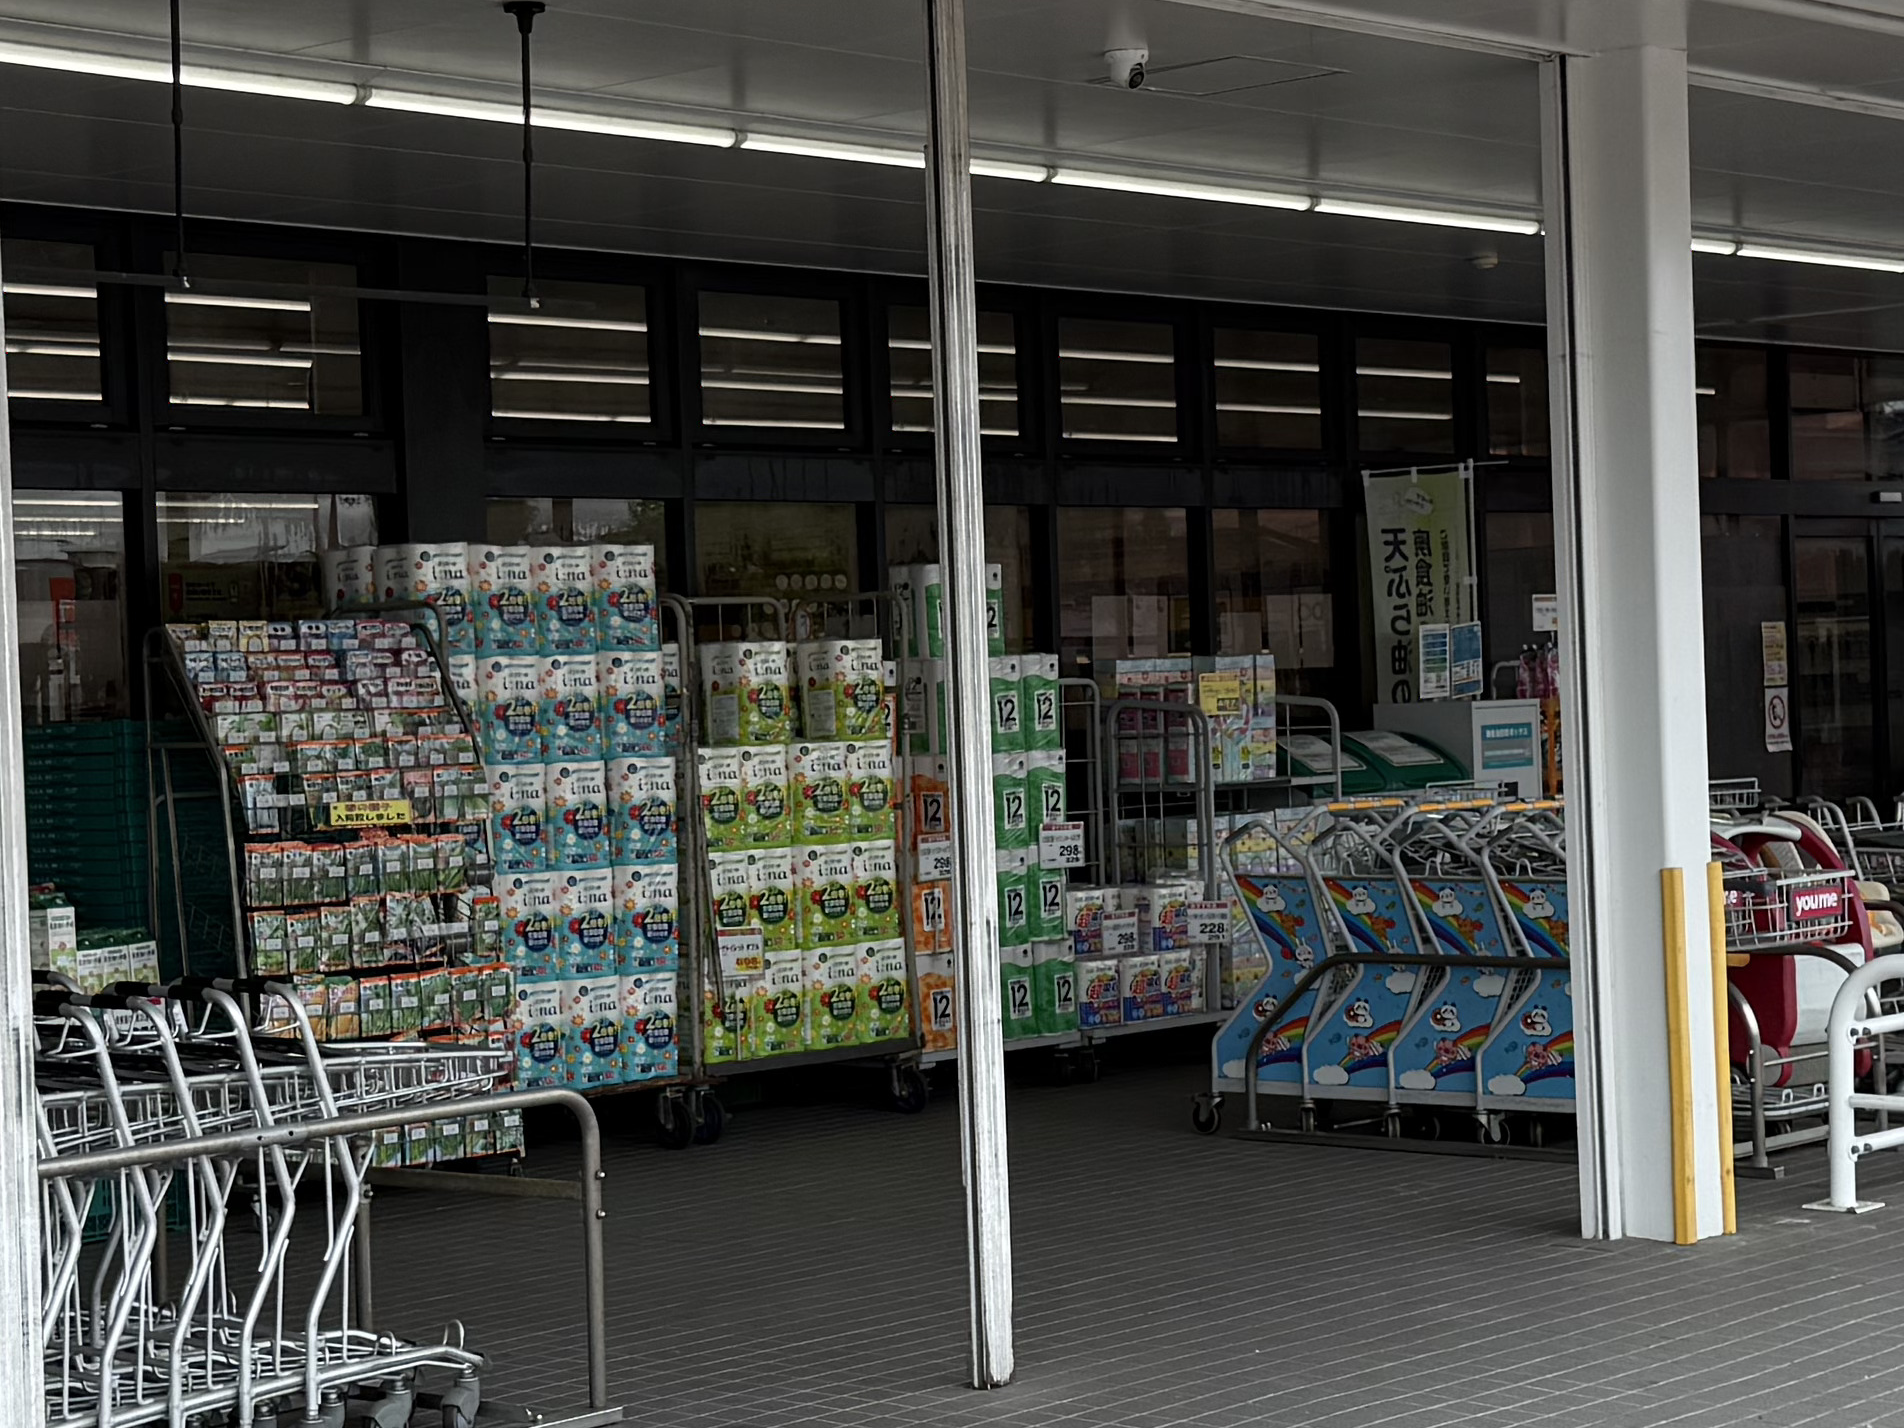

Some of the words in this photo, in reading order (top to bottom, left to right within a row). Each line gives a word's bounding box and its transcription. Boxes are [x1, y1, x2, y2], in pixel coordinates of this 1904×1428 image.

[1059, 844, 1079, 857] 298
[1795, 892, 1838, 917] youme
[1200, 922, 1225, 934] 228
